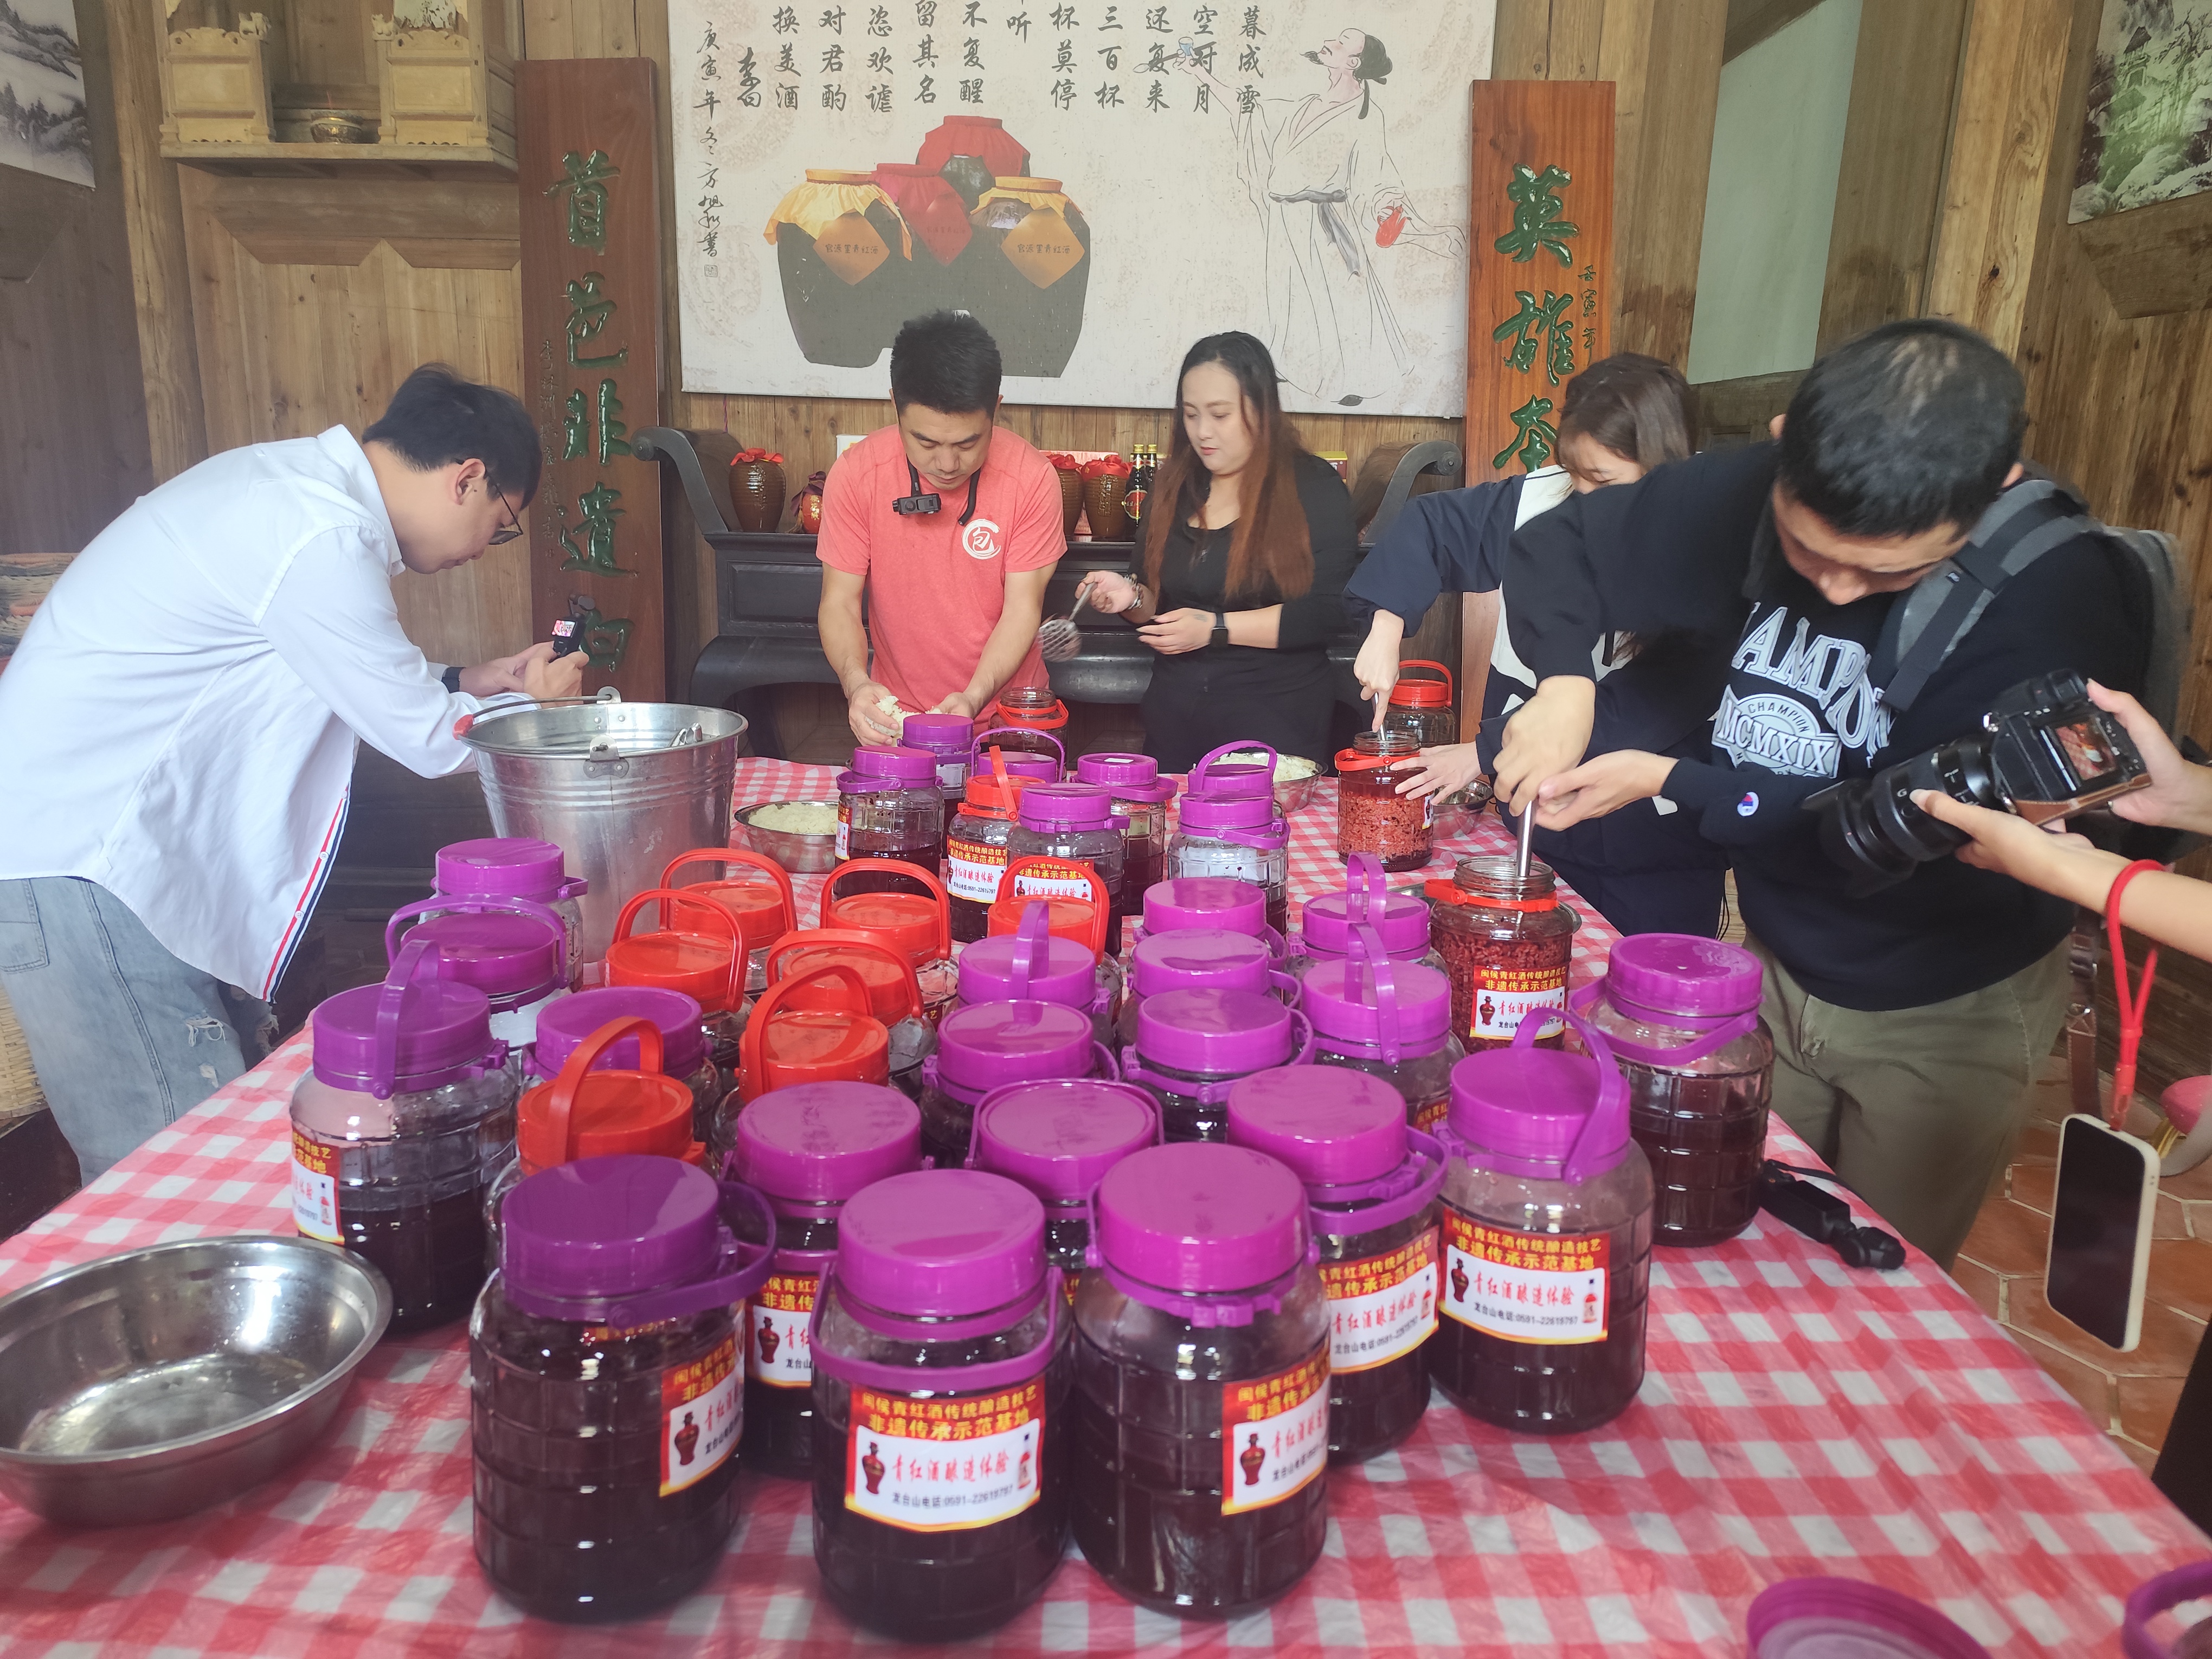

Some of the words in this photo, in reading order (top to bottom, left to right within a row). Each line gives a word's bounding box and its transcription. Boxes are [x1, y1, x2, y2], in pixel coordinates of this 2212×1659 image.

[773, 5, 801, 110] 换美酒
[819, 5, 846, 111] 对君酌
[913, 0, 939, 104] 留其名
[1049, 2, 1079, 111] 杯莫停
[1095, 6, 1124, 109] 三百杯
[1236, 5, 1266, 113] 暮成雪
[1716, 700, 1834, 775] MCMXIX
[1748, 701, 1811, 733] CHAMPION
[893, 1450, 1009, 1483] 青红酒酿造体验
